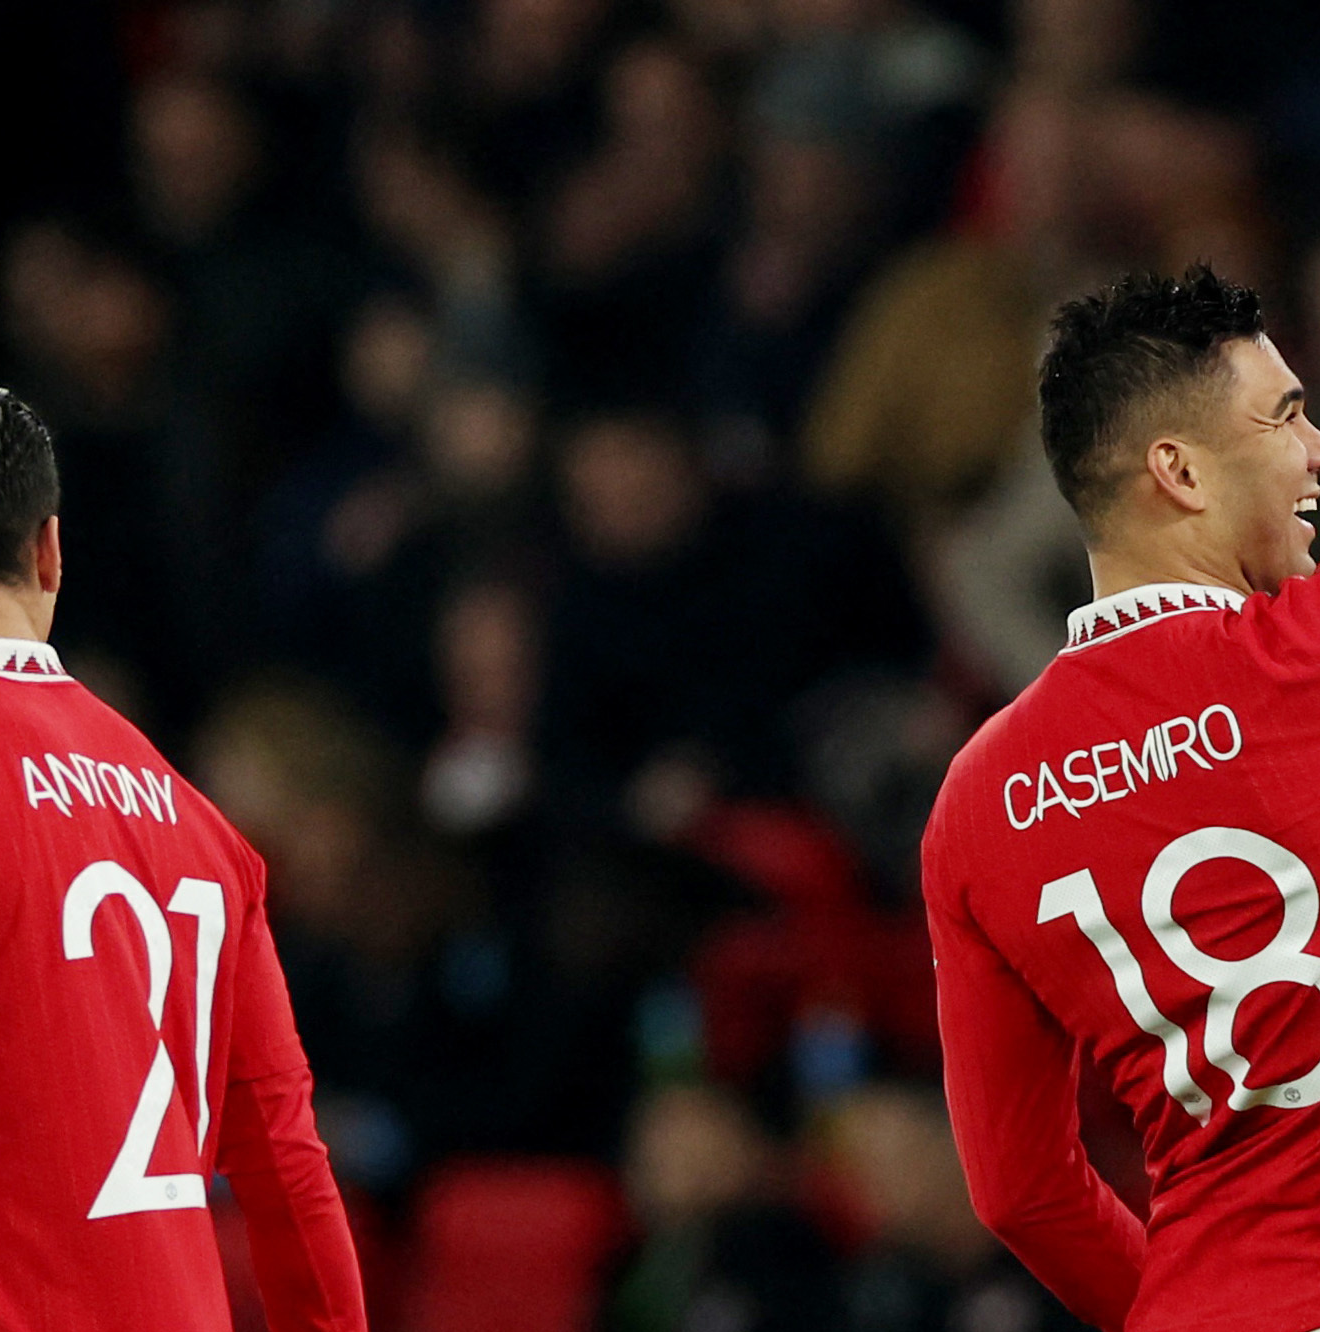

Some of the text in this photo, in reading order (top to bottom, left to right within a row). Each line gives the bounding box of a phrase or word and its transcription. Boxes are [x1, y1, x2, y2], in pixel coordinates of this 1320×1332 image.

[22, 752, 177, 825] ANTONY
[1003, 704, 1242, 830] CASEMIRO
[63, 861, 226, 1219] 21
